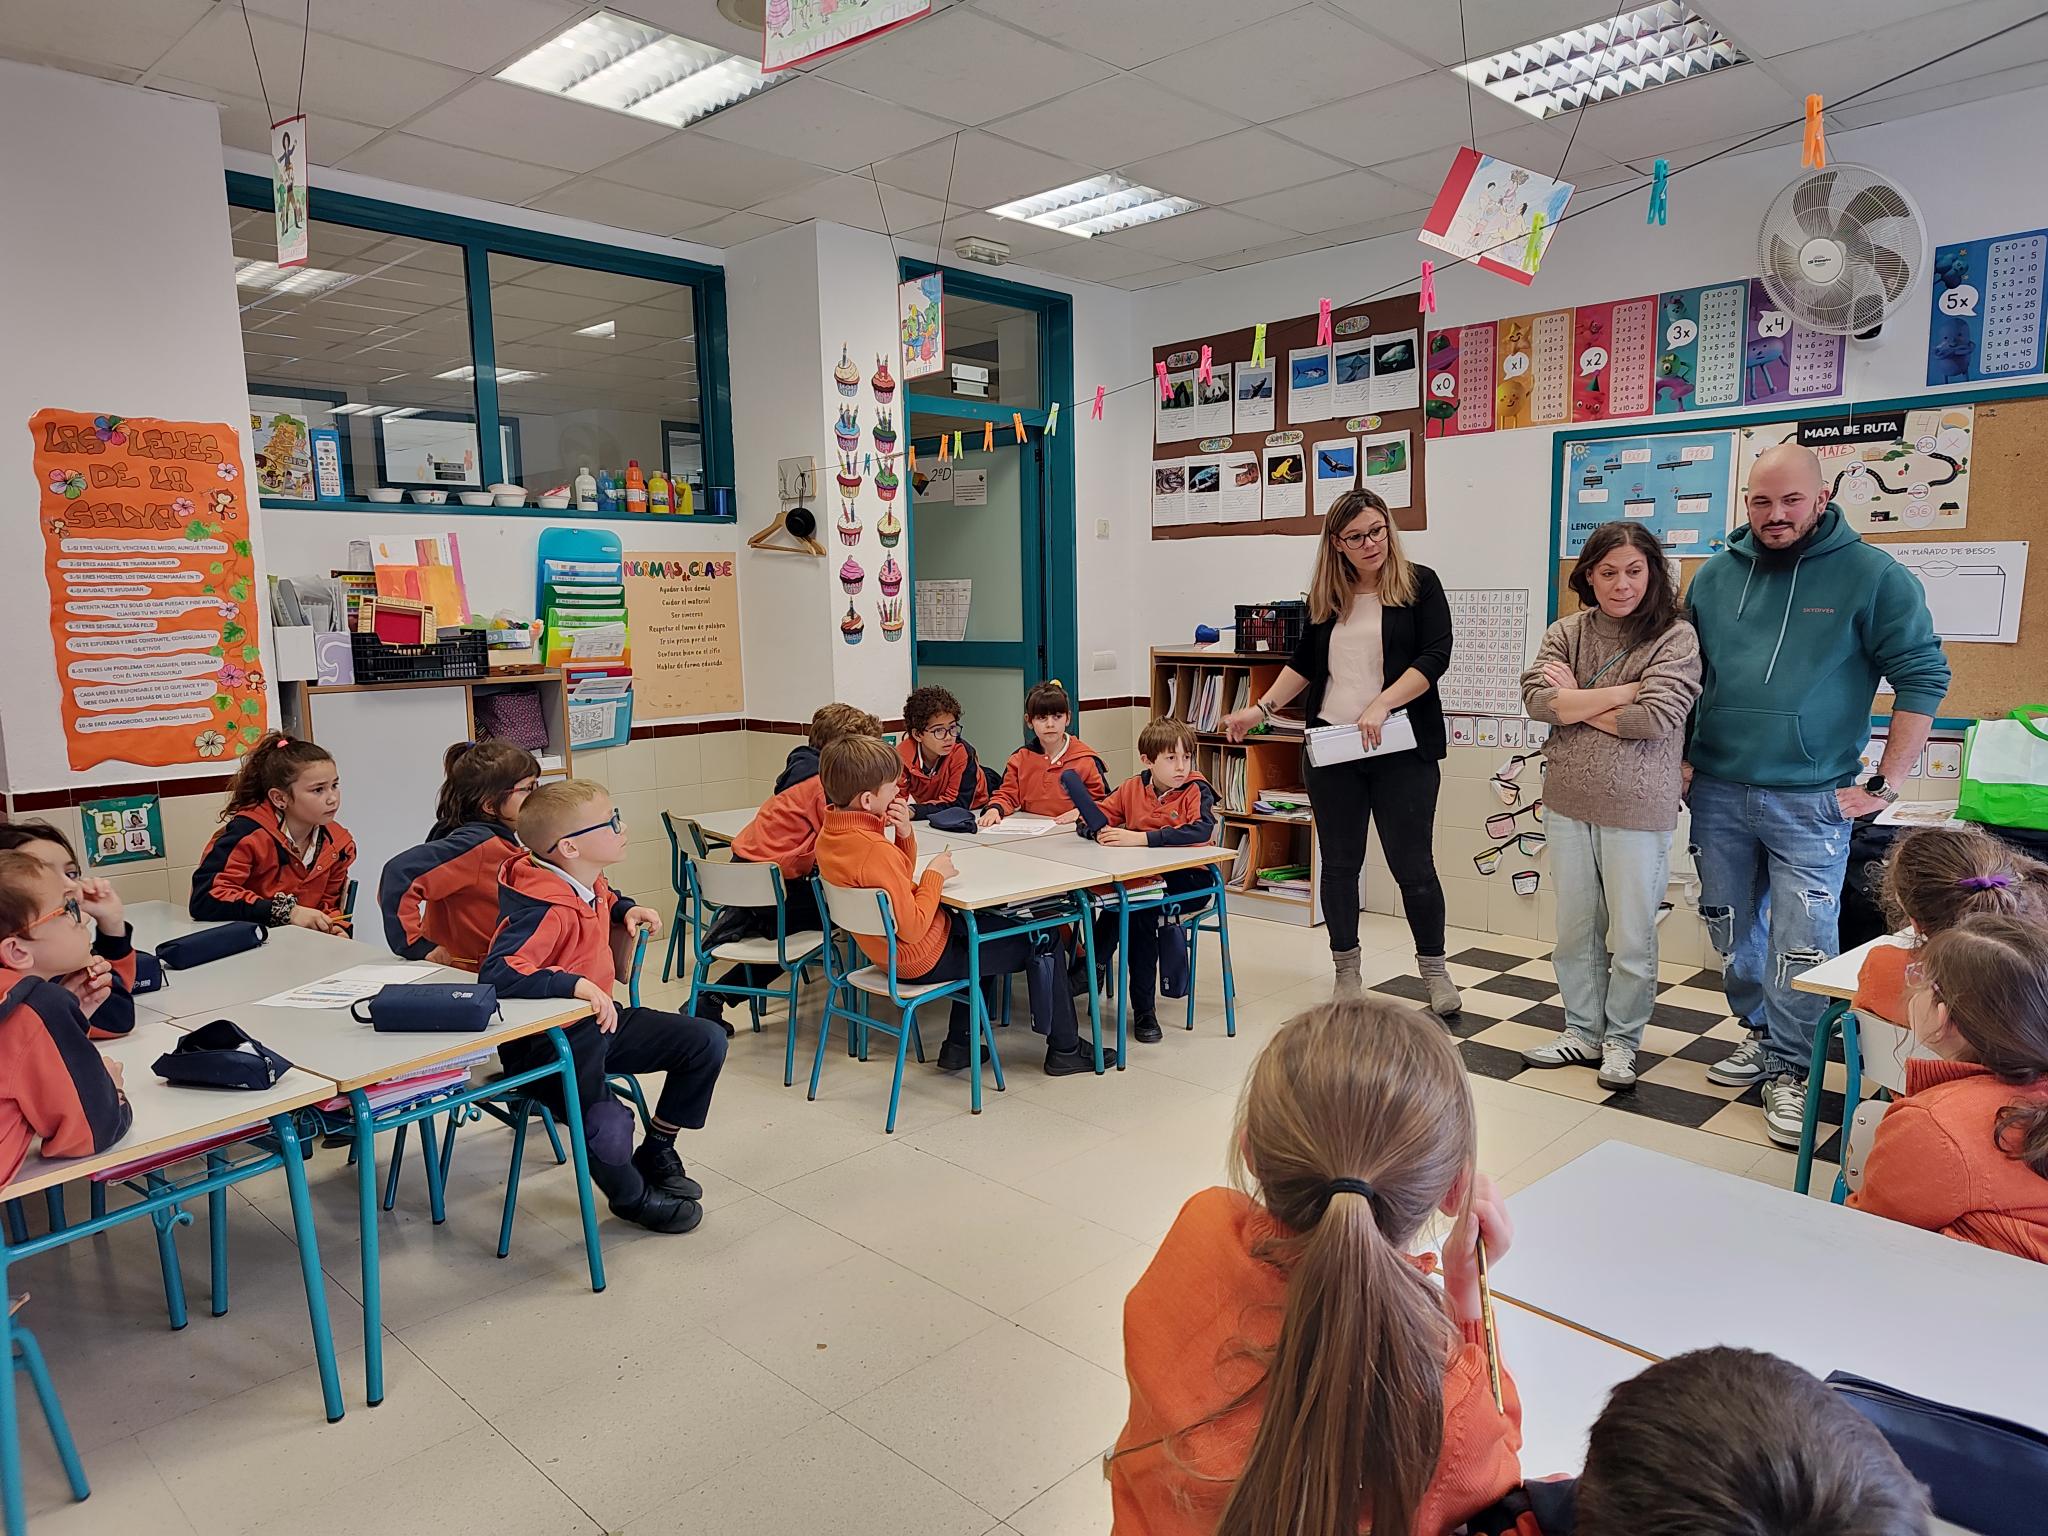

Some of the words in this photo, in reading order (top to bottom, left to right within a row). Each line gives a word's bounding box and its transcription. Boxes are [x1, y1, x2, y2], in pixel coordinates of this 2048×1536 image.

[2025, 288, 2037, 296] 20
[1804, 428, 1840, 439] MAPA
[1842, 426, 1860, 435] DE
[1864, 422, 1898, 433] RUTA
[44, 422, 106, 455] LAS
[127, 429, 224, 464] LEYES
[1817, 444, 1856, 458] MATES
[89, 462, 140, 488] DE
[150, 466, 193, 492] LA
[64, 500, 182, 530] SELVA
[1571, 522, 1604, 530] LENGU
[624, 561, 683, 579] NORMAS
[688, 561, 732, 579] CLASE
